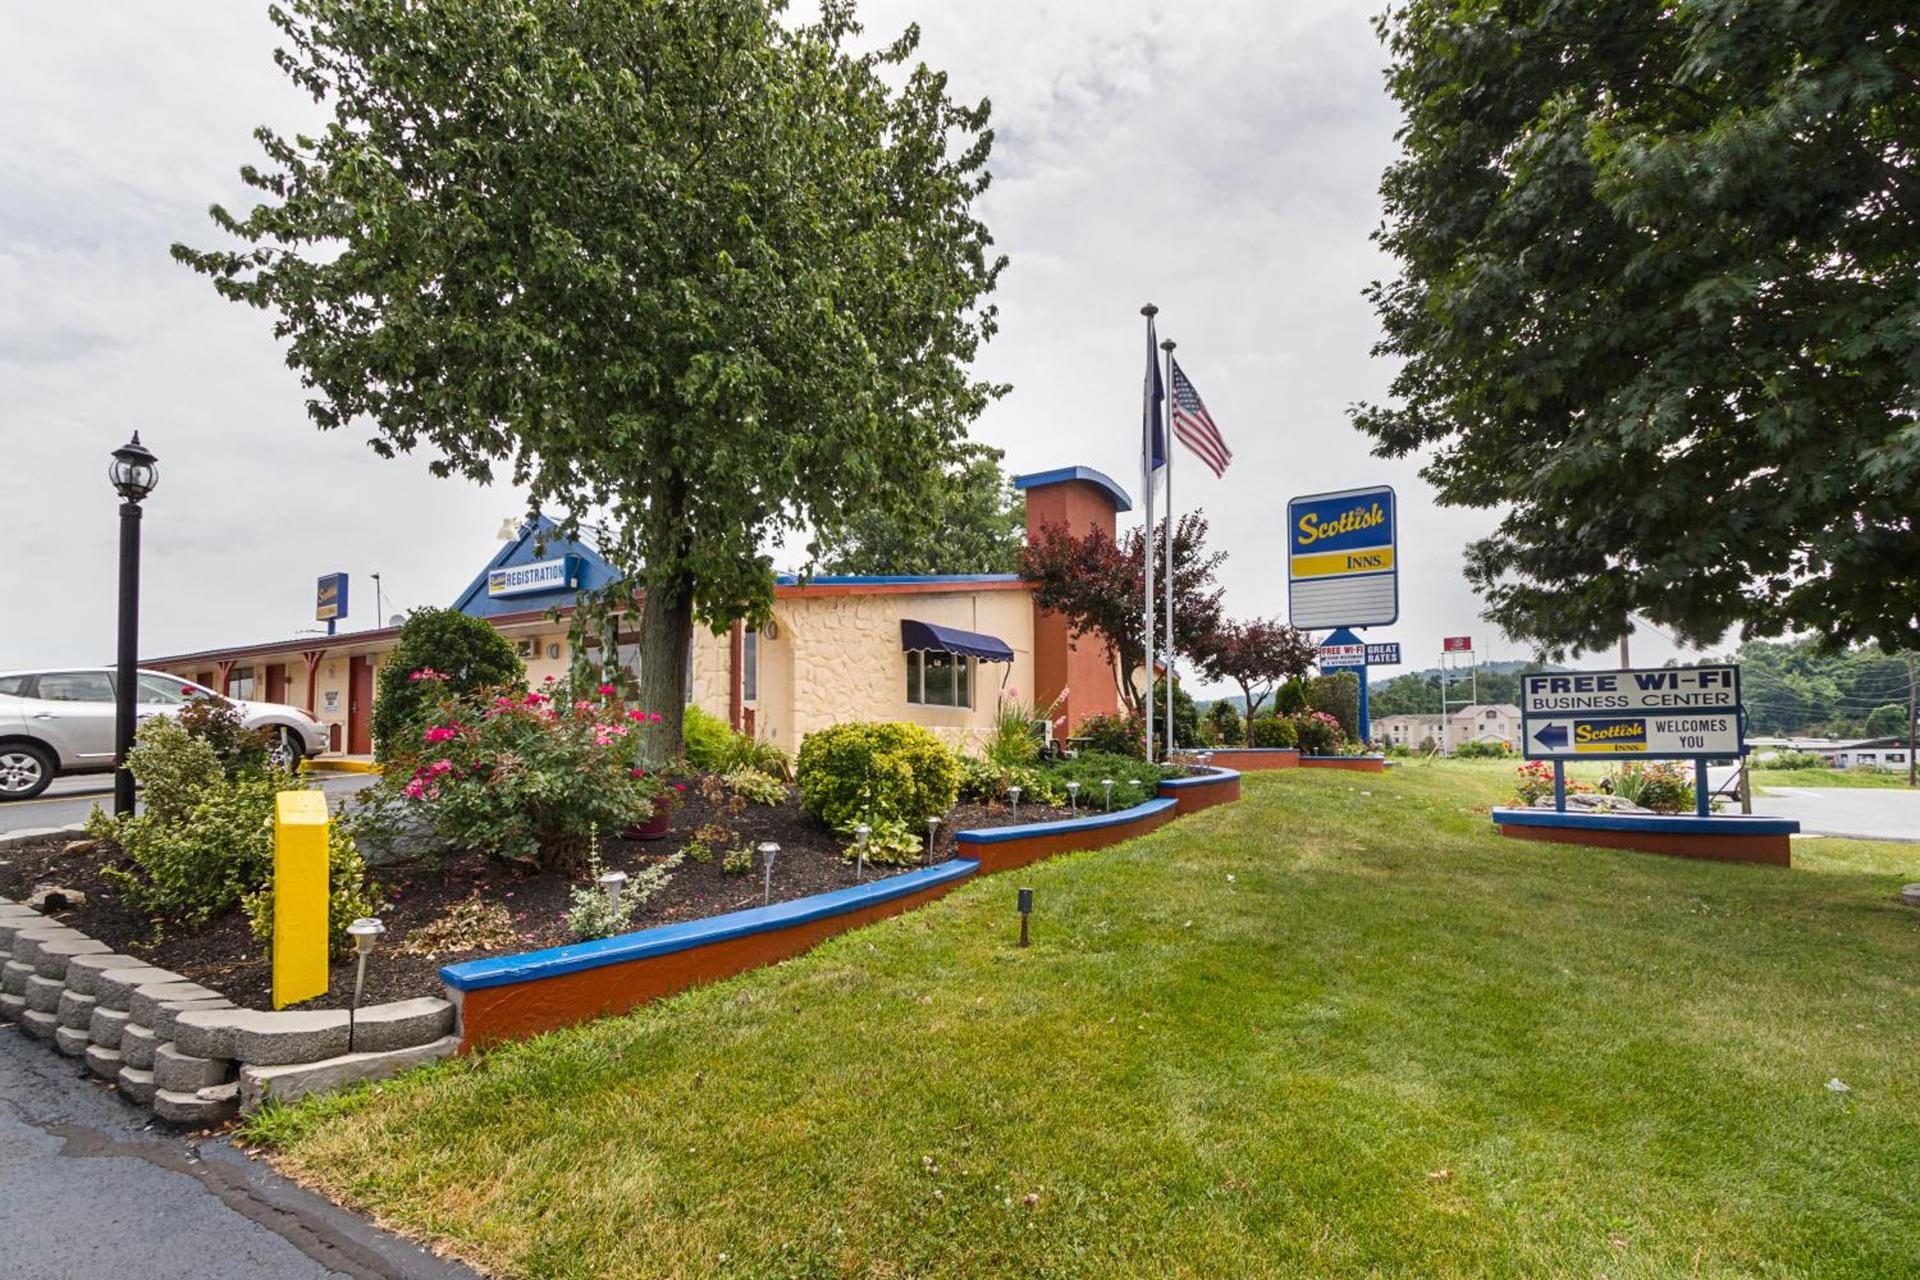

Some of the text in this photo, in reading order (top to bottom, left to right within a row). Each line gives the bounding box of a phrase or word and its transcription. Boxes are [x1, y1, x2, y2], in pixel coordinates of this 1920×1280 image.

[1298, 502, 1385, 545] Scottish
[506, 564, 564, 587] REGISTRATION
[1321, 645, 1363, 655] FREE WI-FI
[1367, 644, 1397, 654] GREAT
[1368, 653, 1398, 662] RATES
[1530, 670, 1731, 694] FREE WI-FI
[1533, 692, 1729, 710] BUSINESS CENTER
[1576, 722, 1645, 743] Scottish
[1656, 719, 1727, 733] WELCOMES
[1679, 735, 1704, 749] YOU
